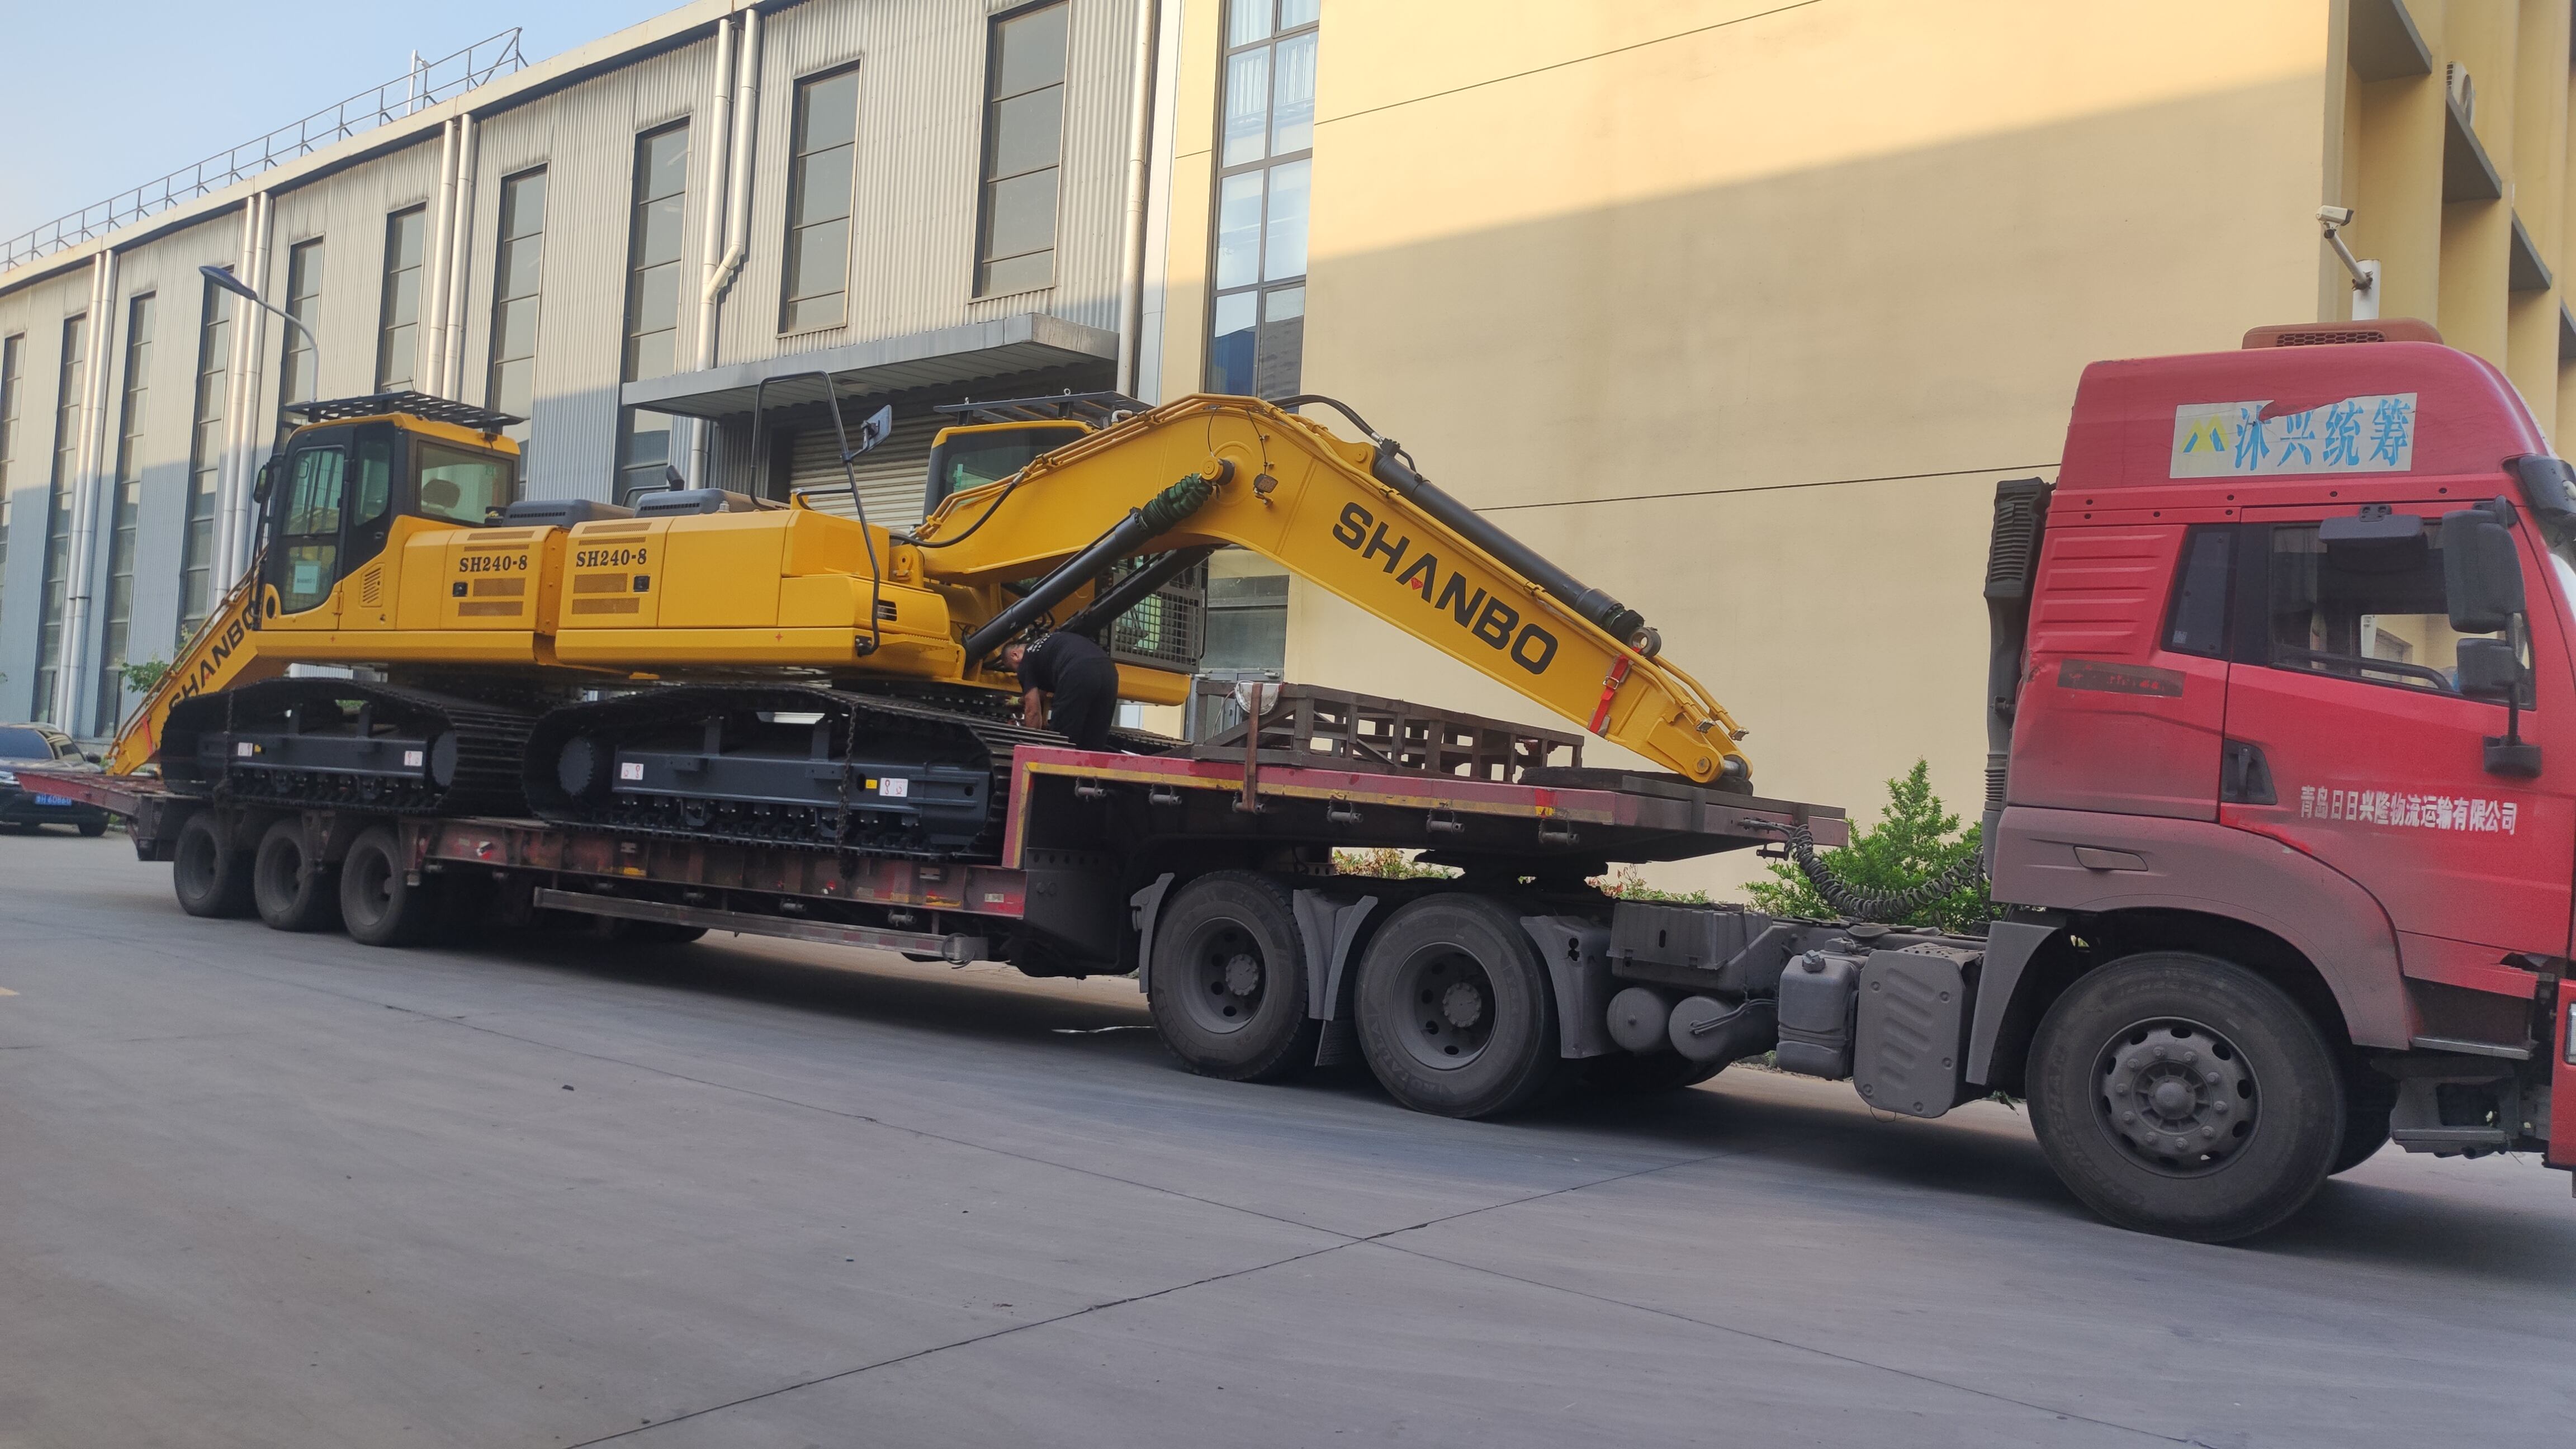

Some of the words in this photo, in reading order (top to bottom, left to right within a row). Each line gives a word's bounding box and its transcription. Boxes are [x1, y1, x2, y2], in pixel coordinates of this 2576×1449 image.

[459, 555, 528, 572] SH240-8
[576, 548, 647, 567] SH240-8
[1332, 501, 1559, 675] SHANBO
[2300, 785, 2517, 835] 青岛日日兴隆物流运输有限公司
